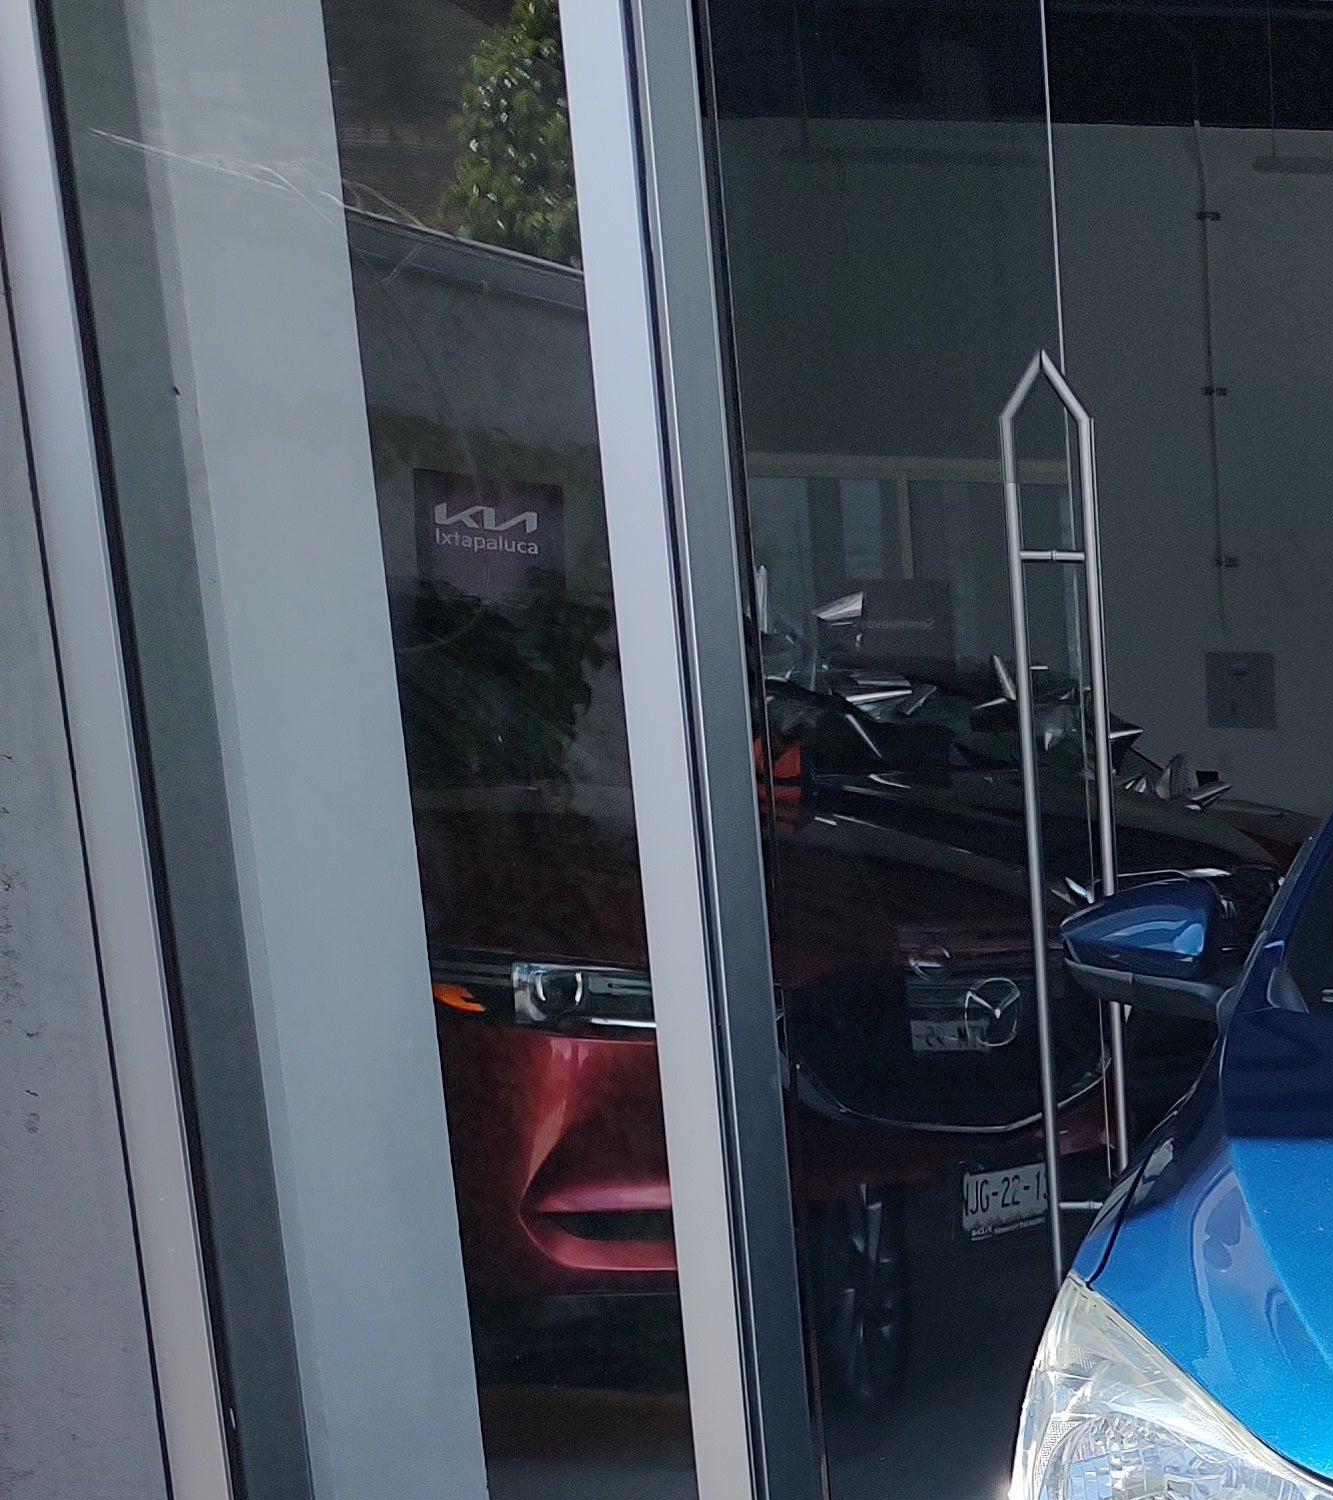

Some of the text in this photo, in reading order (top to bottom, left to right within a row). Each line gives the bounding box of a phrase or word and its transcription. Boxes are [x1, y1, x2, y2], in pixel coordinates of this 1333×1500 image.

[434, 502, 538, 534] KIA
[434, 528, 538, 555] Ixtapaluca
[964, 1171, 1048, 1216] JG-22-1
